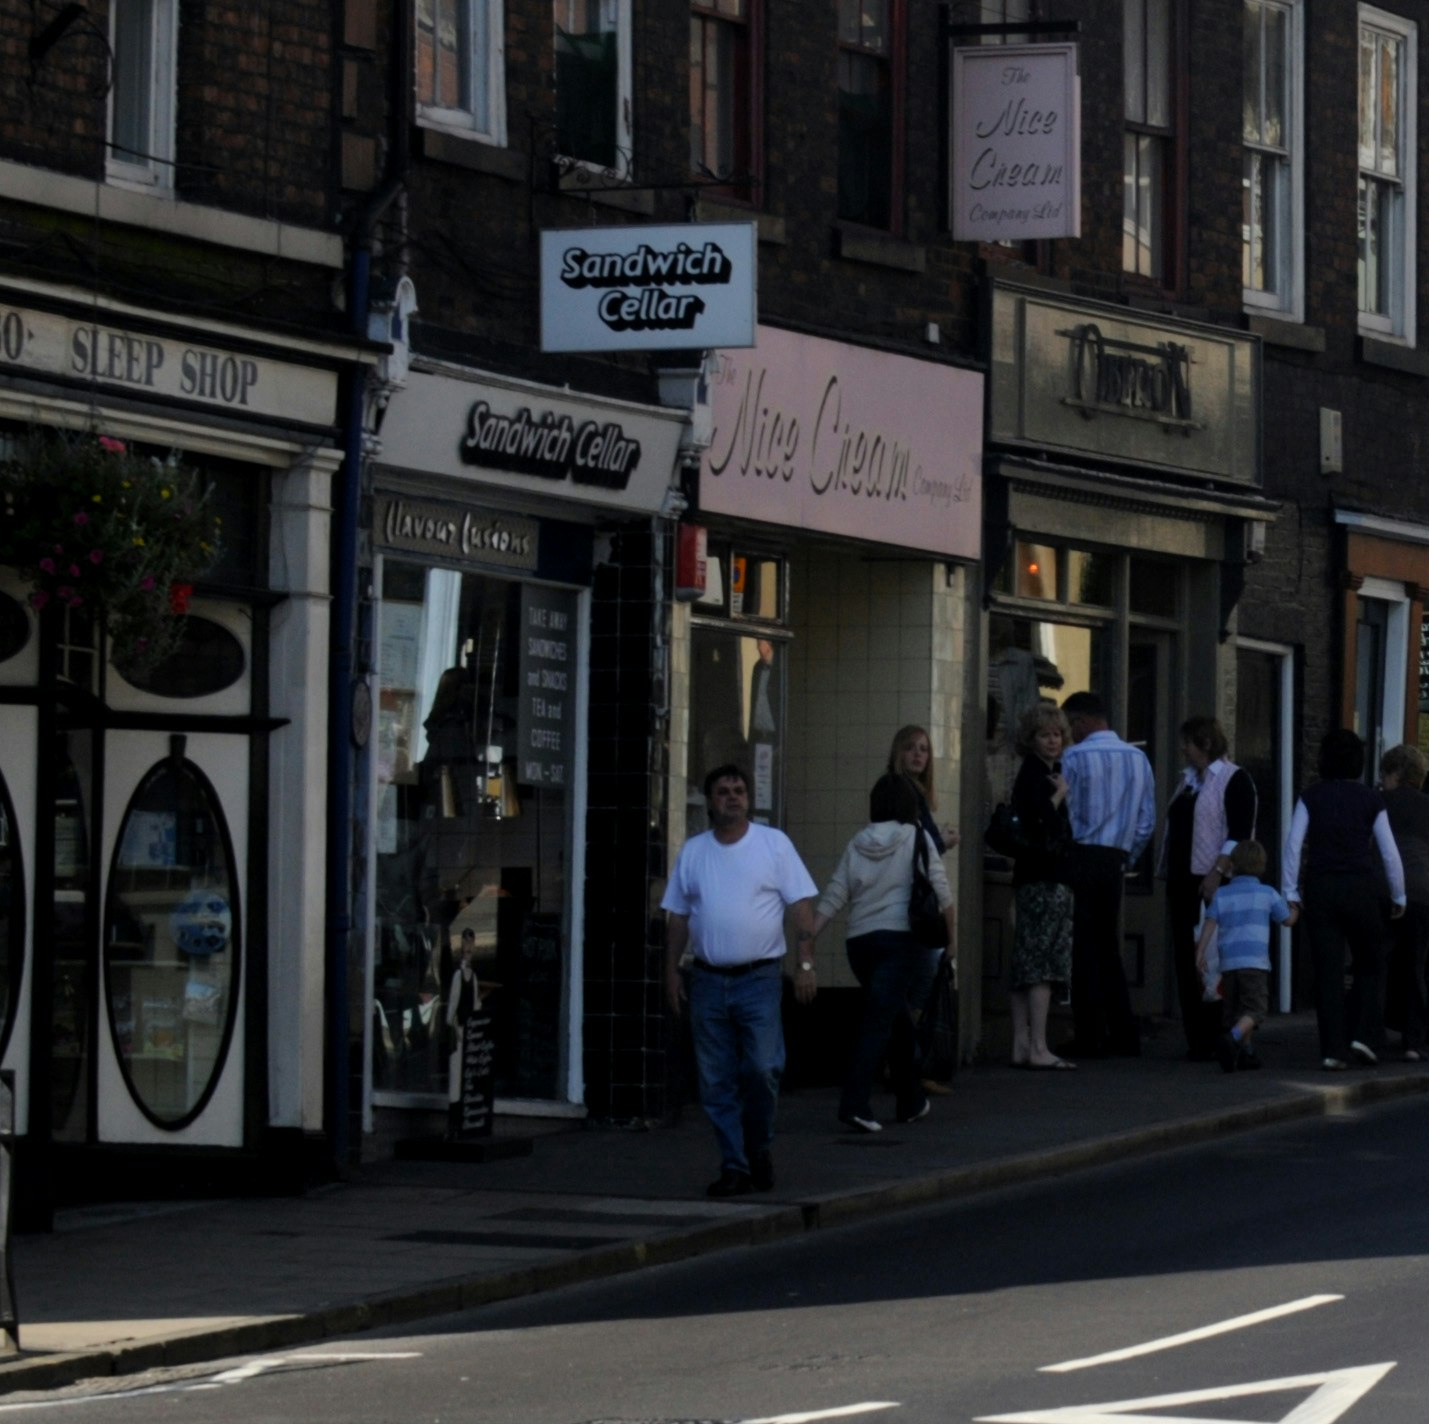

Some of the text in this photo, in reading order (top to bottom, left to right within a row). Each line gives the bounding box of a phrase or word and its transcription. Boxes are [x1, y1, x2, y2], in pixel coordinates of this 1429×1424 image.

[1001, 66, 1031, 86] The
[975, 97, 1058, 139] Nice
[969, 147, 1063, 190] Cream
[969, 201, 1063, 224] Company Ltd
[561, 241, 730, 285] Sandwich
[599, 290, 702, 328] Cellar
[71, 327, 165, 388] SLEEP
[180, 350, 258, 406] SHOP
[463, 401, 640, 476] Sandwich Cellar
[709, 368, 799, 482] Nice
[810, 376, 910, 501] Cream
